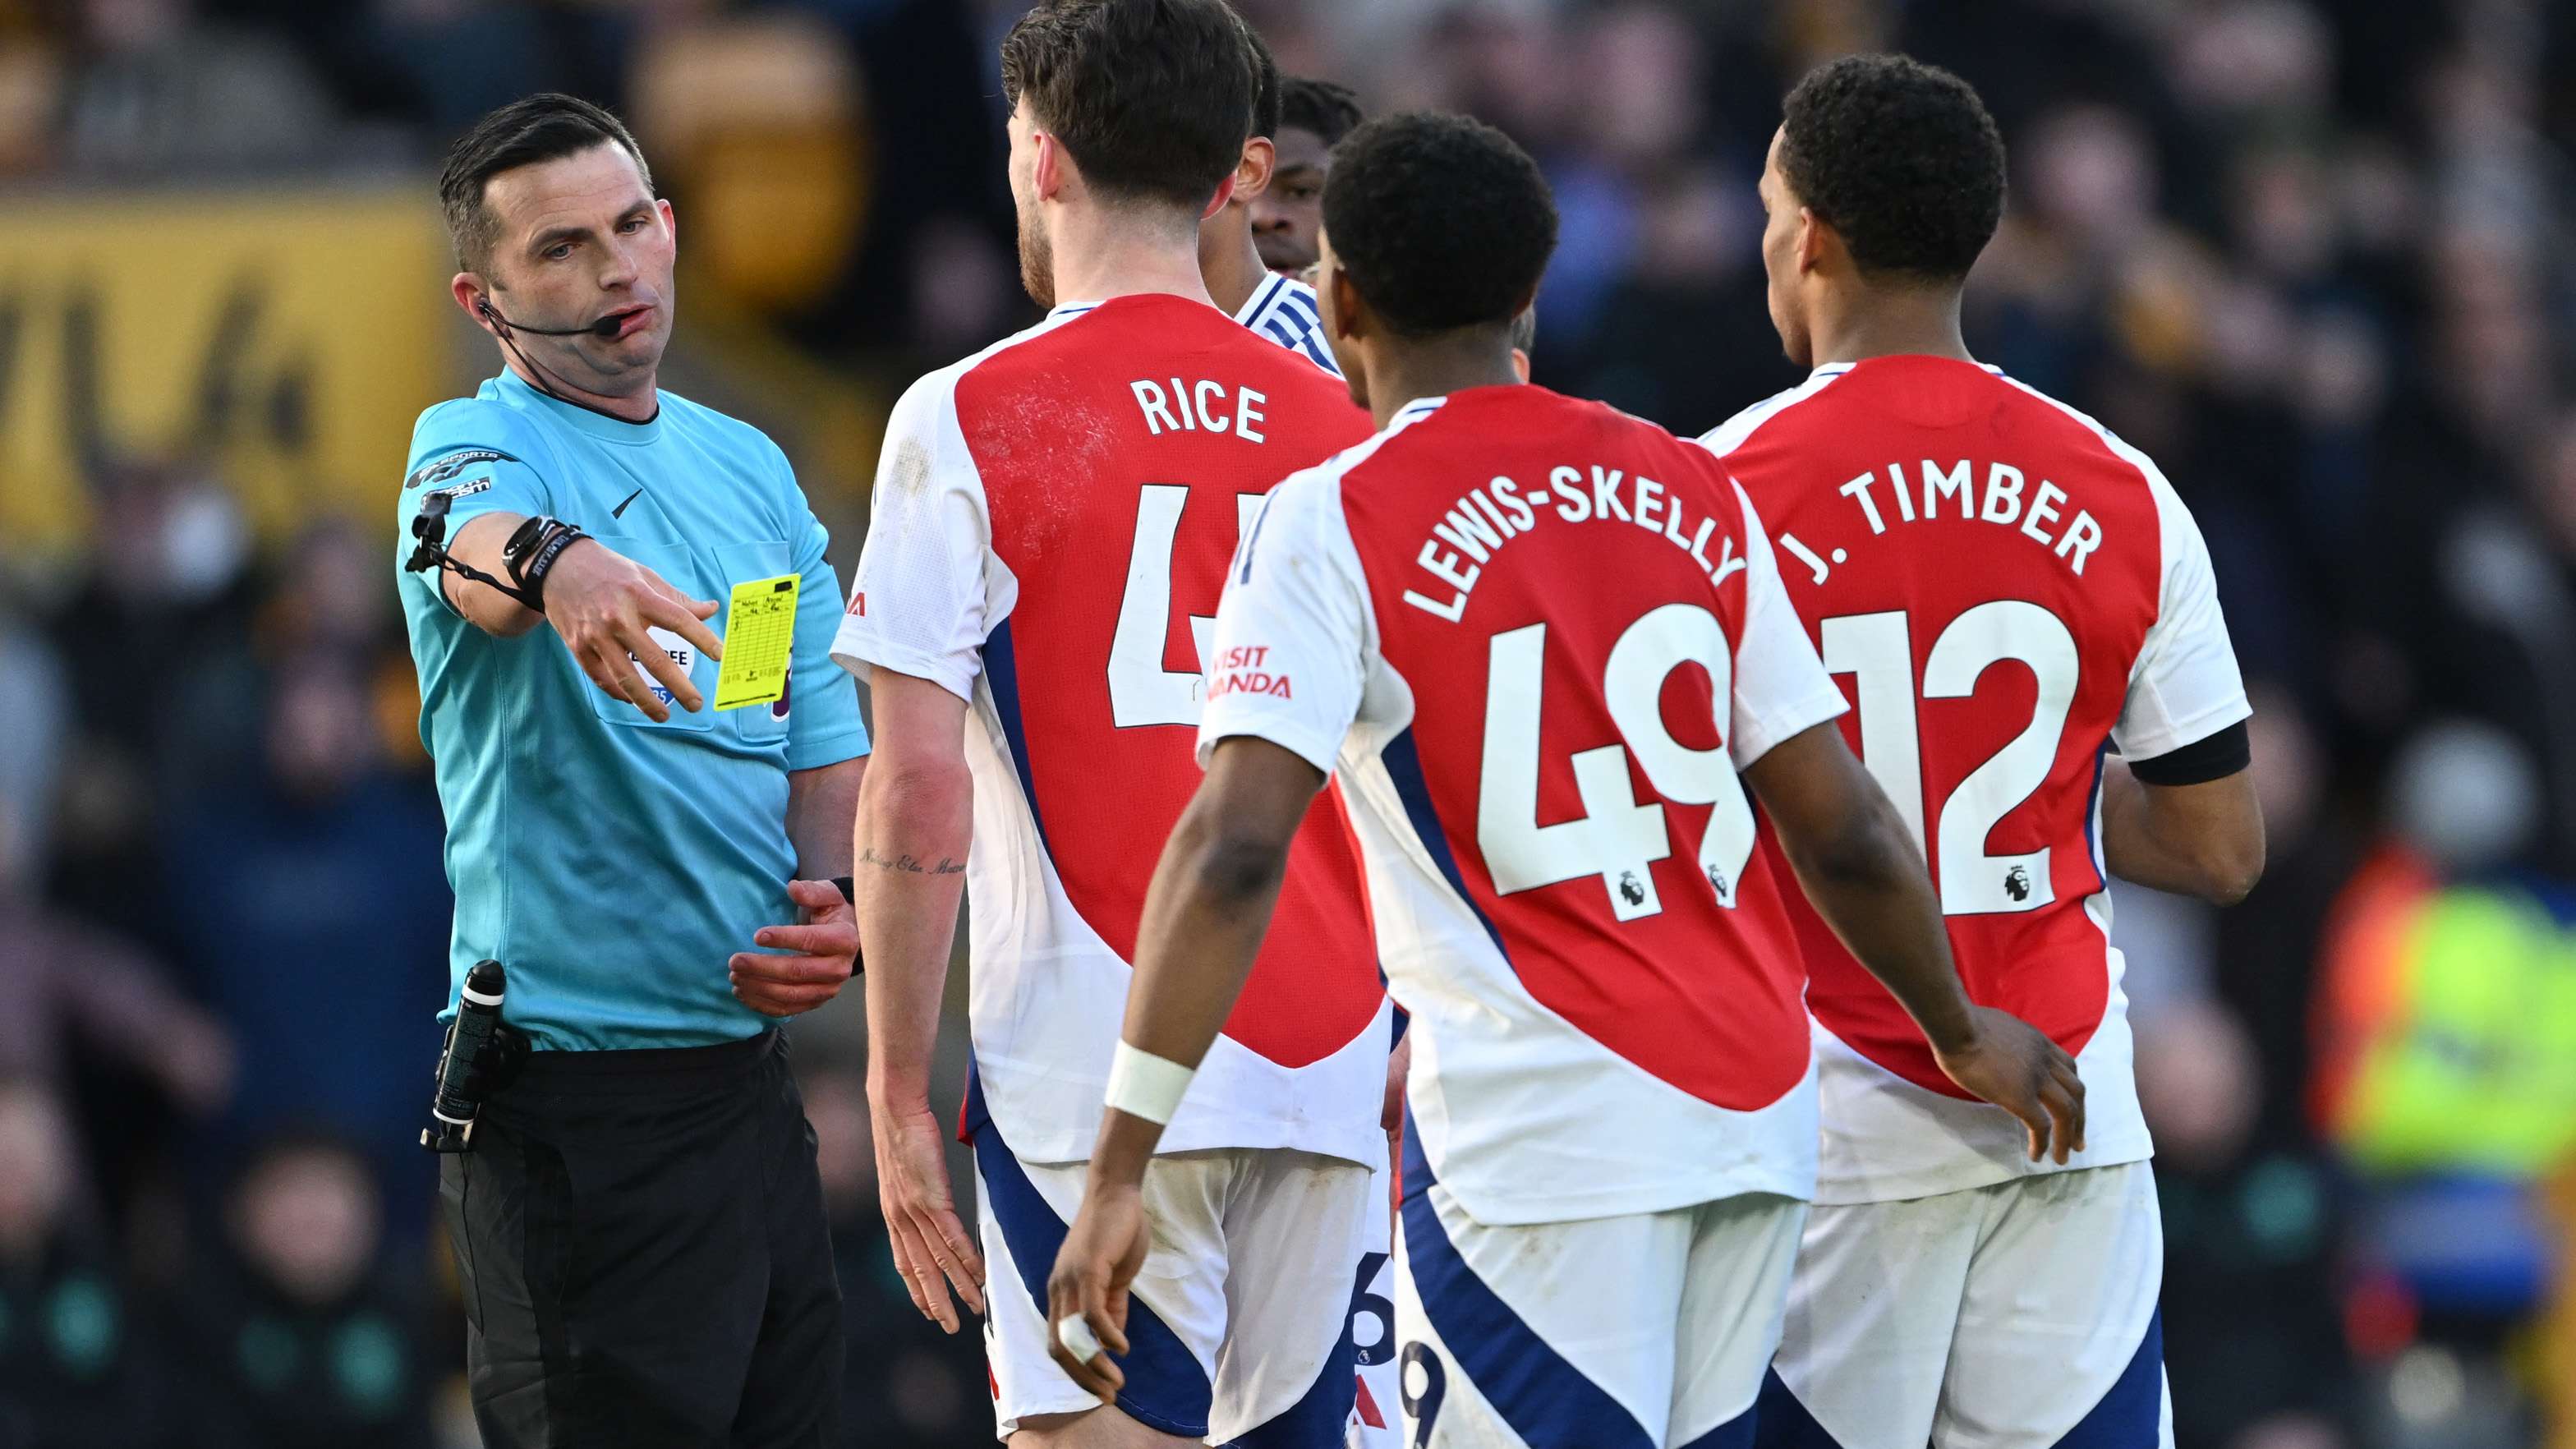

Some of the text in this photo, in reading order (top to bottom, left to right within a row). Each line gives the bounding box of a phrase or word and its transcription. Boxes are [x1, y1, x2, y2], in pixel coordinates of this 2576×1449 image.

[1130, 377, 1267, 444] RICE
[1403, 465, 1747, 623] LEWIS-SKELLY
[1779, 458, 2103, 586] J. TIMBER
[1476, 602, 1757, 922] 49
[1820, 599, 2081, 916] 12
[1350, 1251, 1396, 1367] 6
[1400, 1340, 1447, 1449] 9
